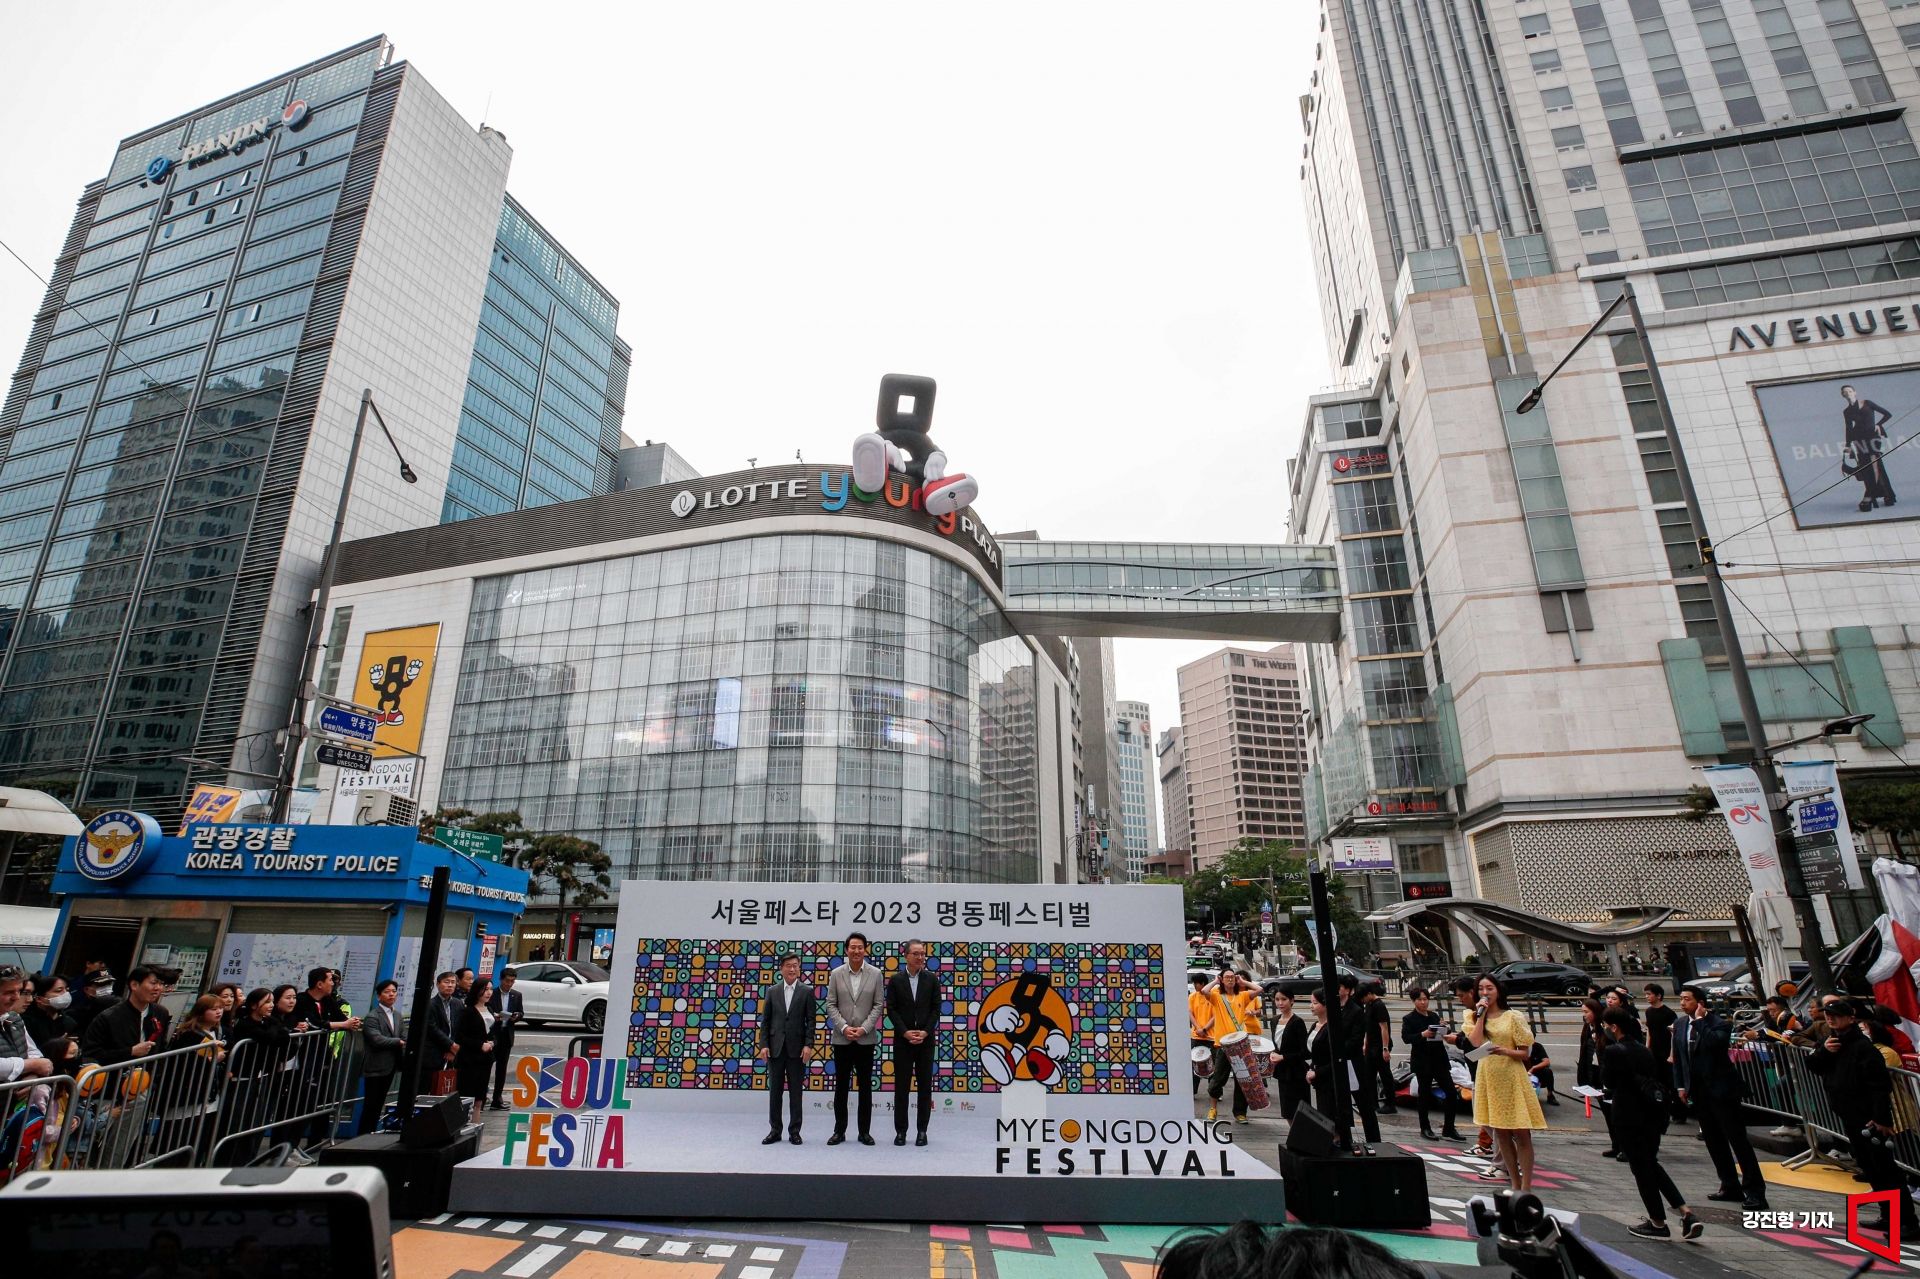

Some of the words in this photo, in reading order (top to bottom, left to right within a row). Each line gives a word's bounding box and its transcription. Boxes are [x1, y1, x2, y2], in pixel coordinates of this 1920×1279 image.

[181, 117, 270, 164] HANJIN
[704, 480, 808, 510] LOTTE
[961, 515, 999, 571] PLAZA
[1252, 658, 1267, 669] THE
[351, 716, 375, 732] 명동길
[336, 749, 370, 764] 유네스코길
[336, 760, 367, 770] UNESCO-Rd
[341, 773, 410, 787] FESTIVAL
[1800, 805, 1817, 817] 명동길
[1801, 813, 1837, 825] Myeongdong-gil
[192, 826, 297, 851] 관광경찰
[454, 831, 471, 839] 서울역
[185, 852, 243, 870] KOREA
[253, 853, 328, 872] TOURIST
[333, 855, 399, 873] POLICE
[1648, 850, 1680, 860] LOUIS
[1284, 871, 1304, 881] FAST
[451, 881, 475, 895] KOREA
[477, 885, 503, 900] TOURIST
[711, 898, 840, 926] 서울페스타
[852, 901, 922, 924] 2023
[936, 900, 1092, 928] 명동페스티벌
[228, 959, 242, 968] 관광
[222, 967, 243, 976] 안내도
[513, 1055, 632, 1110] SEOUL
[996, 1118, 1233, 1145] MYEONGDONG
[502, 1112, 625, 1169] FESTA
[996, 1147, 1236, 1177] FESTIVAL
